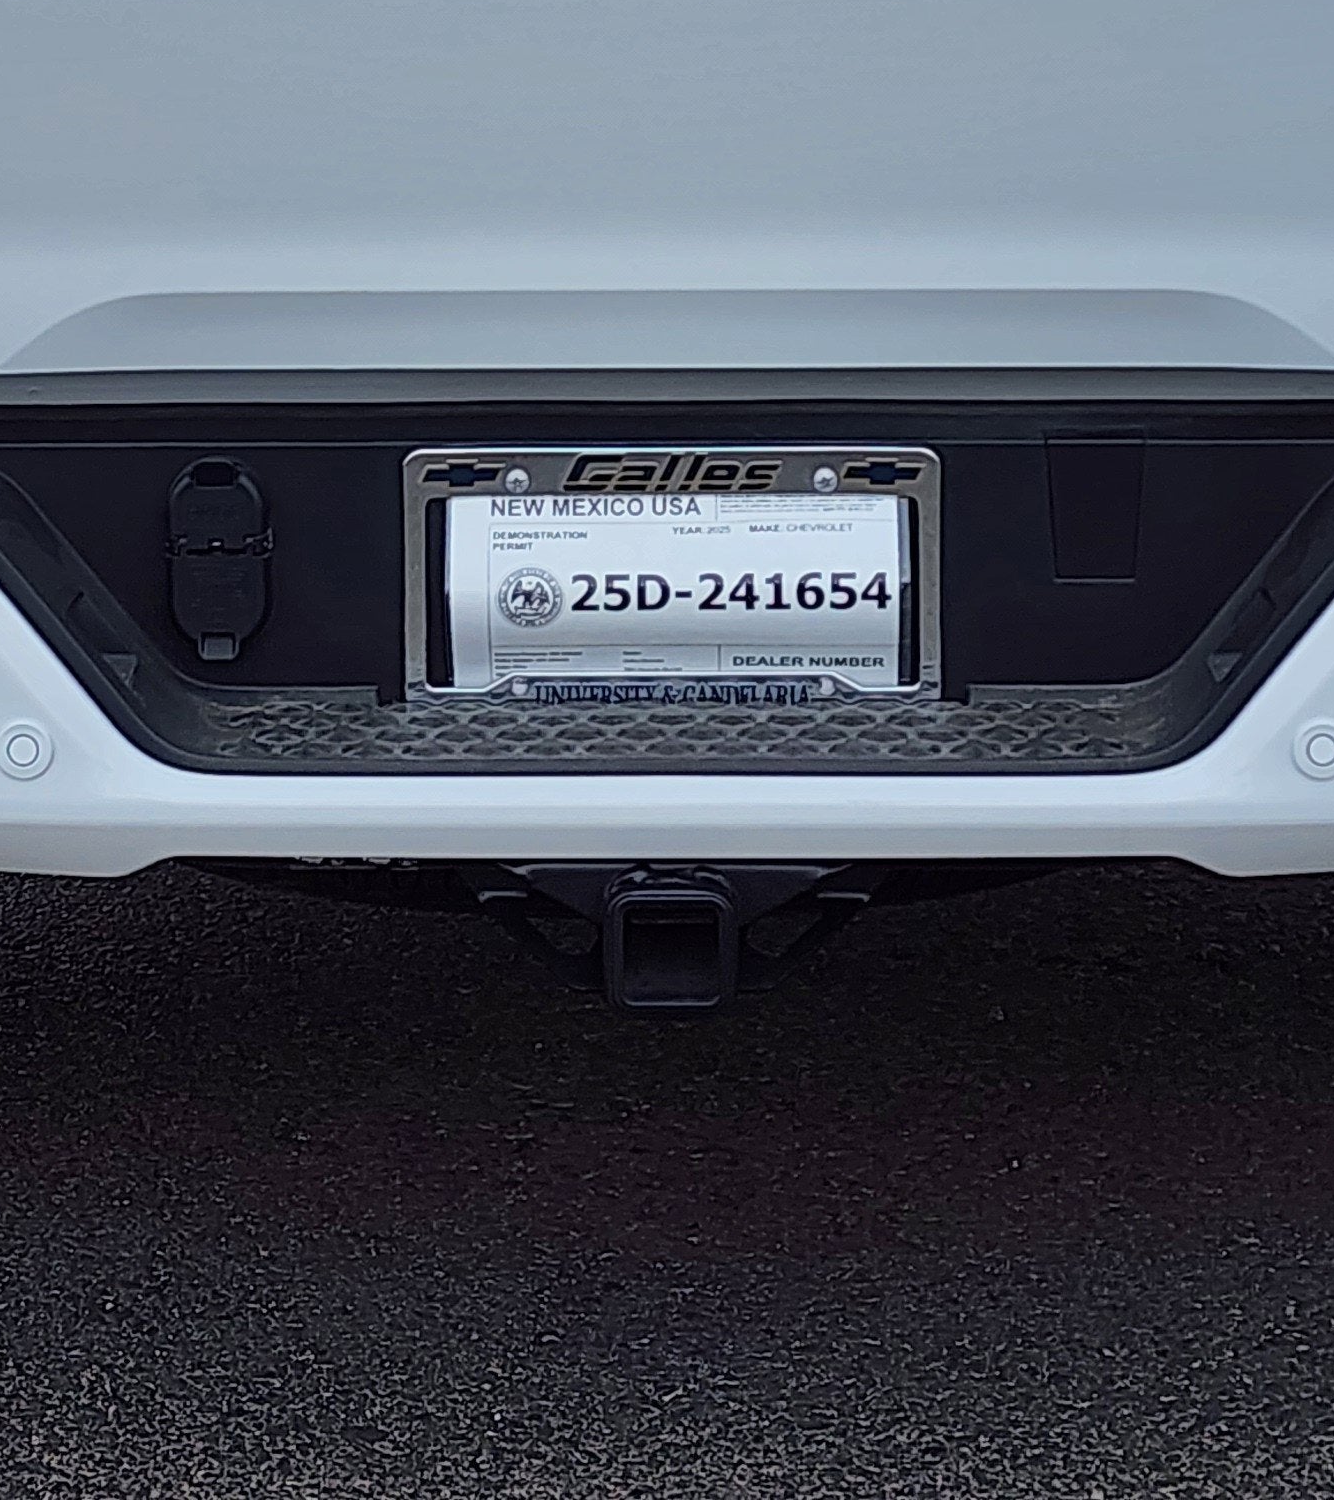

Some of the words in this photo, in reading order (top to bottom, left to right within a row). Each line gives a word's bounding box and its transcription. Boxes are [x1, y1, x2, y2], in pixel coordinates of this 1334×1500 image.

[562, 452, 783, 492] Galles
[491, 499, 544, 517] NEW
[552, 498, 644, 517] MEXICO
[652, 497, 701, 516] USA
[492, 531, 588, 540] DEMONSTRATION
[786, 523, 853, 532] CHEVROLET
[492, 542, 533, 550] PERMIT
[571, 572, 892, 611] 25D-241654
[732, 656, 804, 667] DEALER
[809, 657, 885, 668] NUMBER
[534, 682, 659, 704] UNIVERSITY
[678, 682, 809, 705] CANDELARIA
